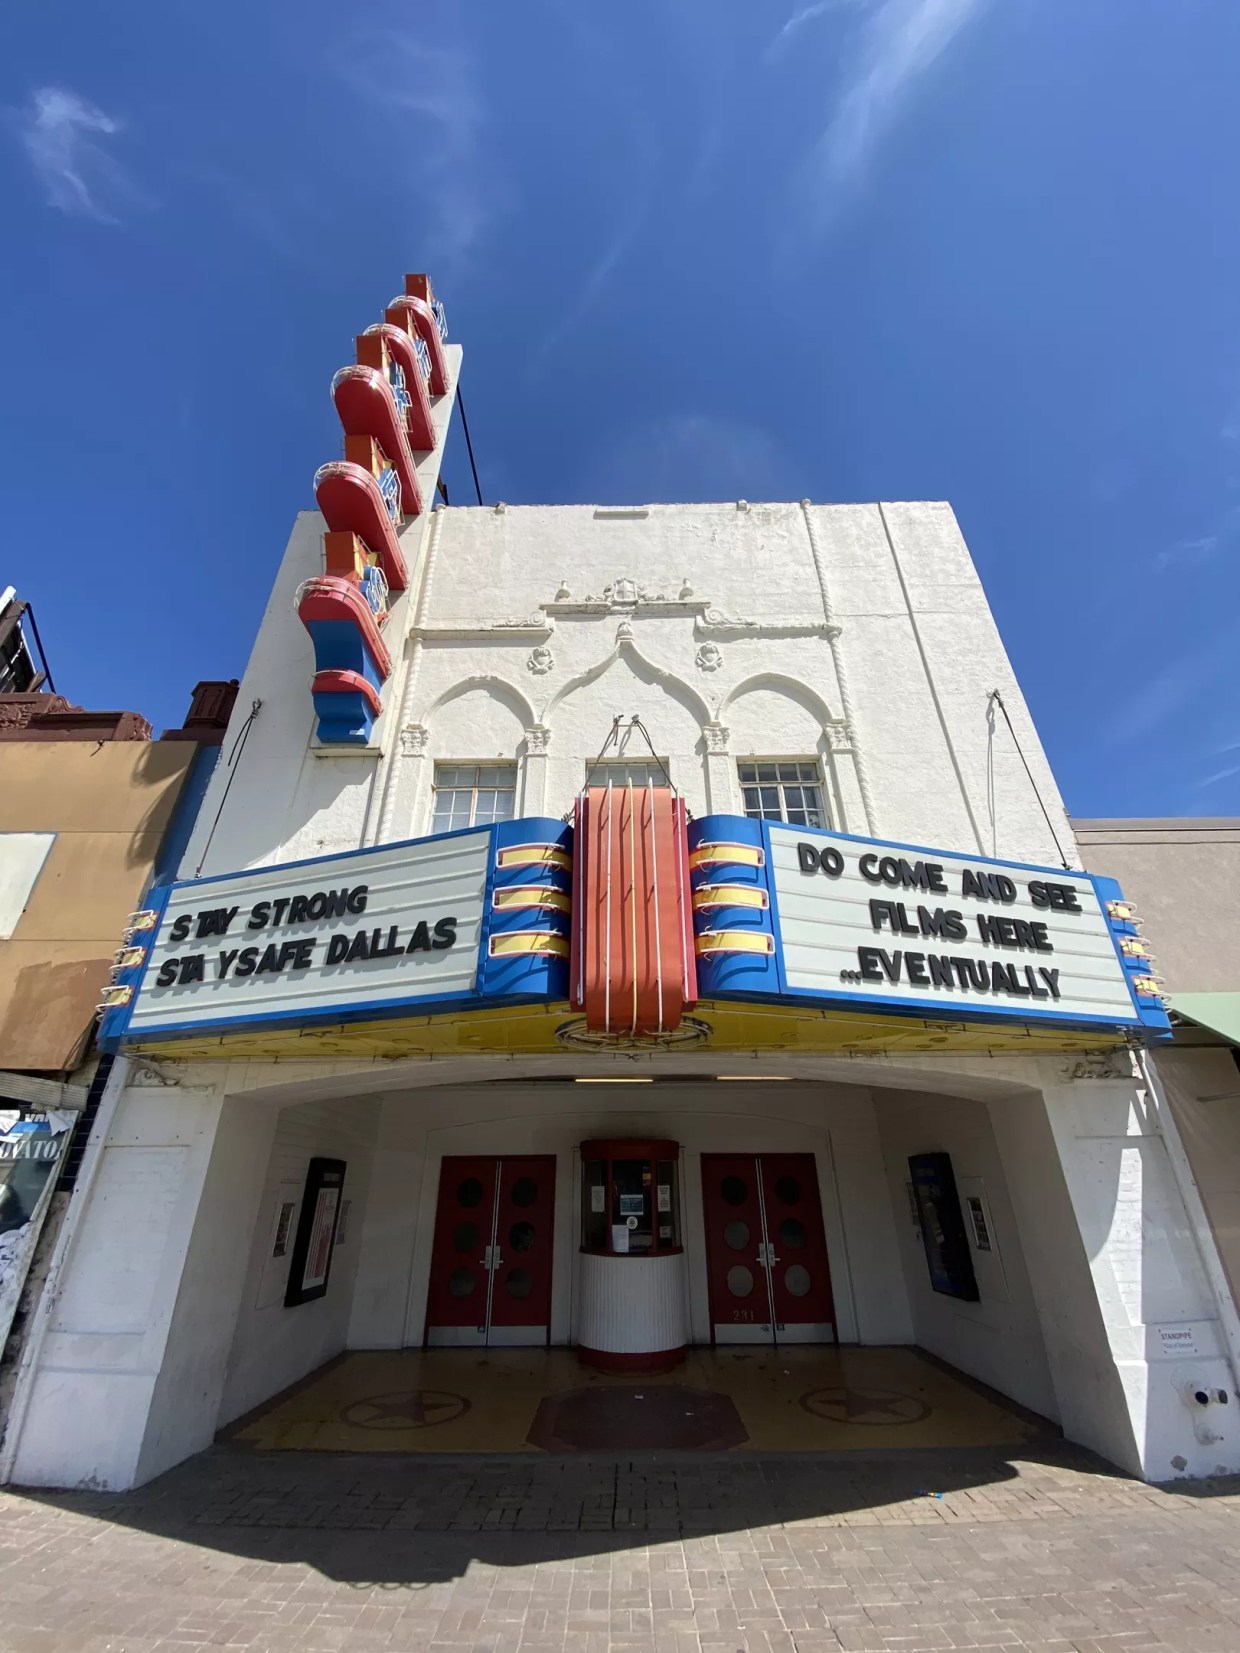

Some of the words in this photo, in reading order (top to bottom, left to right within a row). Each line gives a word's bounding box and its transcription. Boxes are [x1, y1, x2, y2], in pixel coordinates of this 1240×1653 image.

[797, 841, 845, 876] DO
[858, 852, 948, 893] COME
[961, 868, 1017, 901] AND
[1028, 879, 1083, 912] SEE
[169, 906, 239, 942] STAY
[248, 884, 369, 930] STRONG
[869, 898, 968, 940] FILMS
[976, 913, 1054, 951] HERE
[325, 916, 458, 965] DALLAS
[732, 1309, 754, 1321] 231
